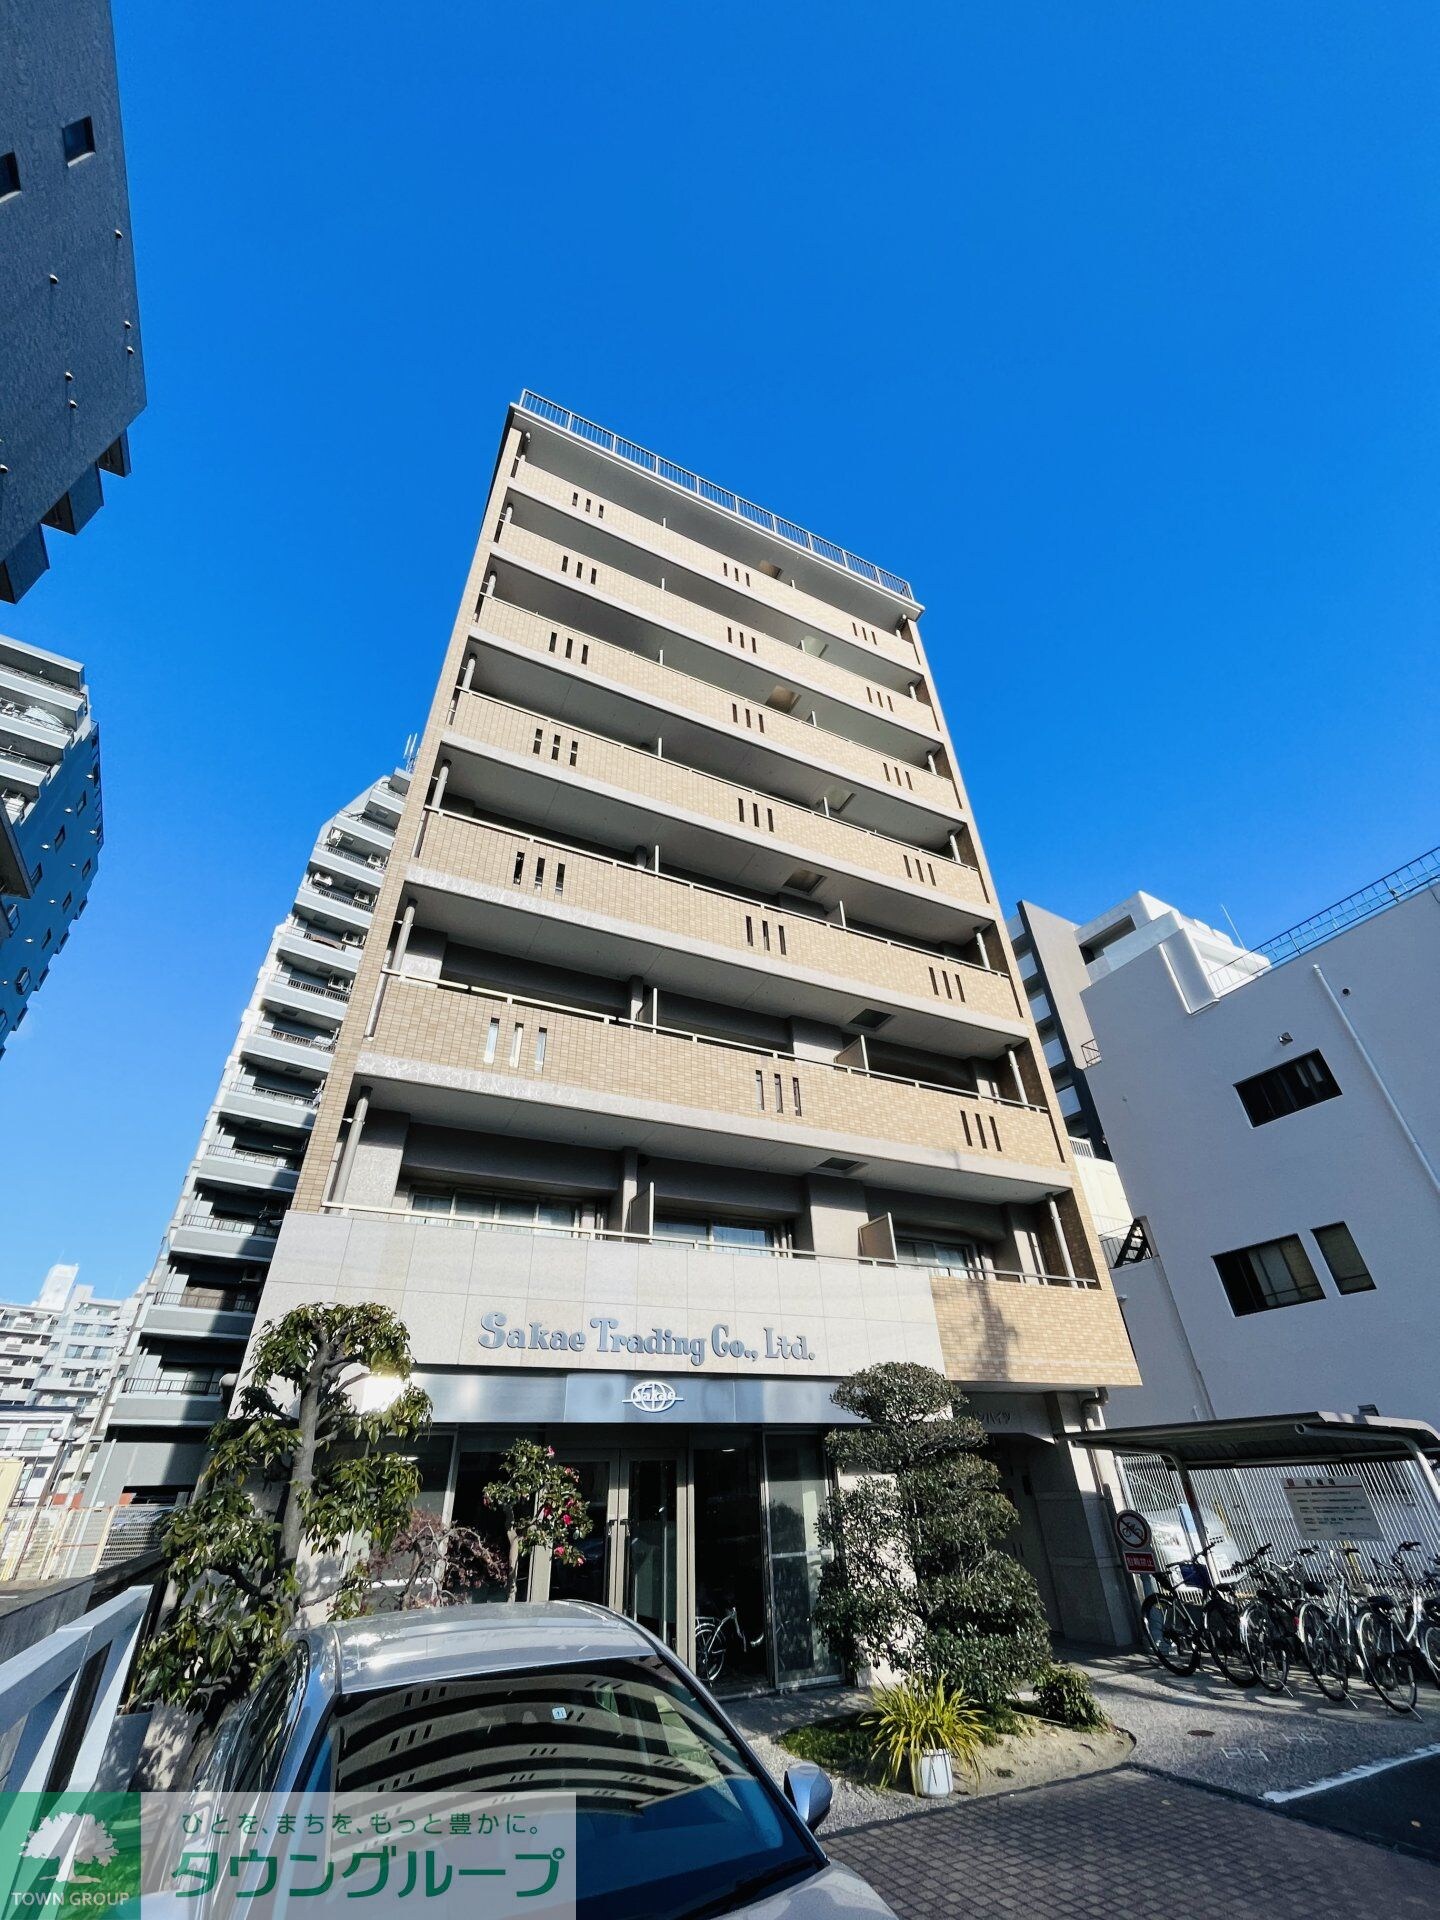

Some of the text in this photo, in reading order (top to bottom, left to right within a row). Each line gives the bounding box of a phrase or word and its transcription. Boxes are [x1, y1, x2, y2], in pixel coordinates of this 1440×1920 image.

[478, 1311, 816, 1367] Sakae Trading Co., Ltd.
